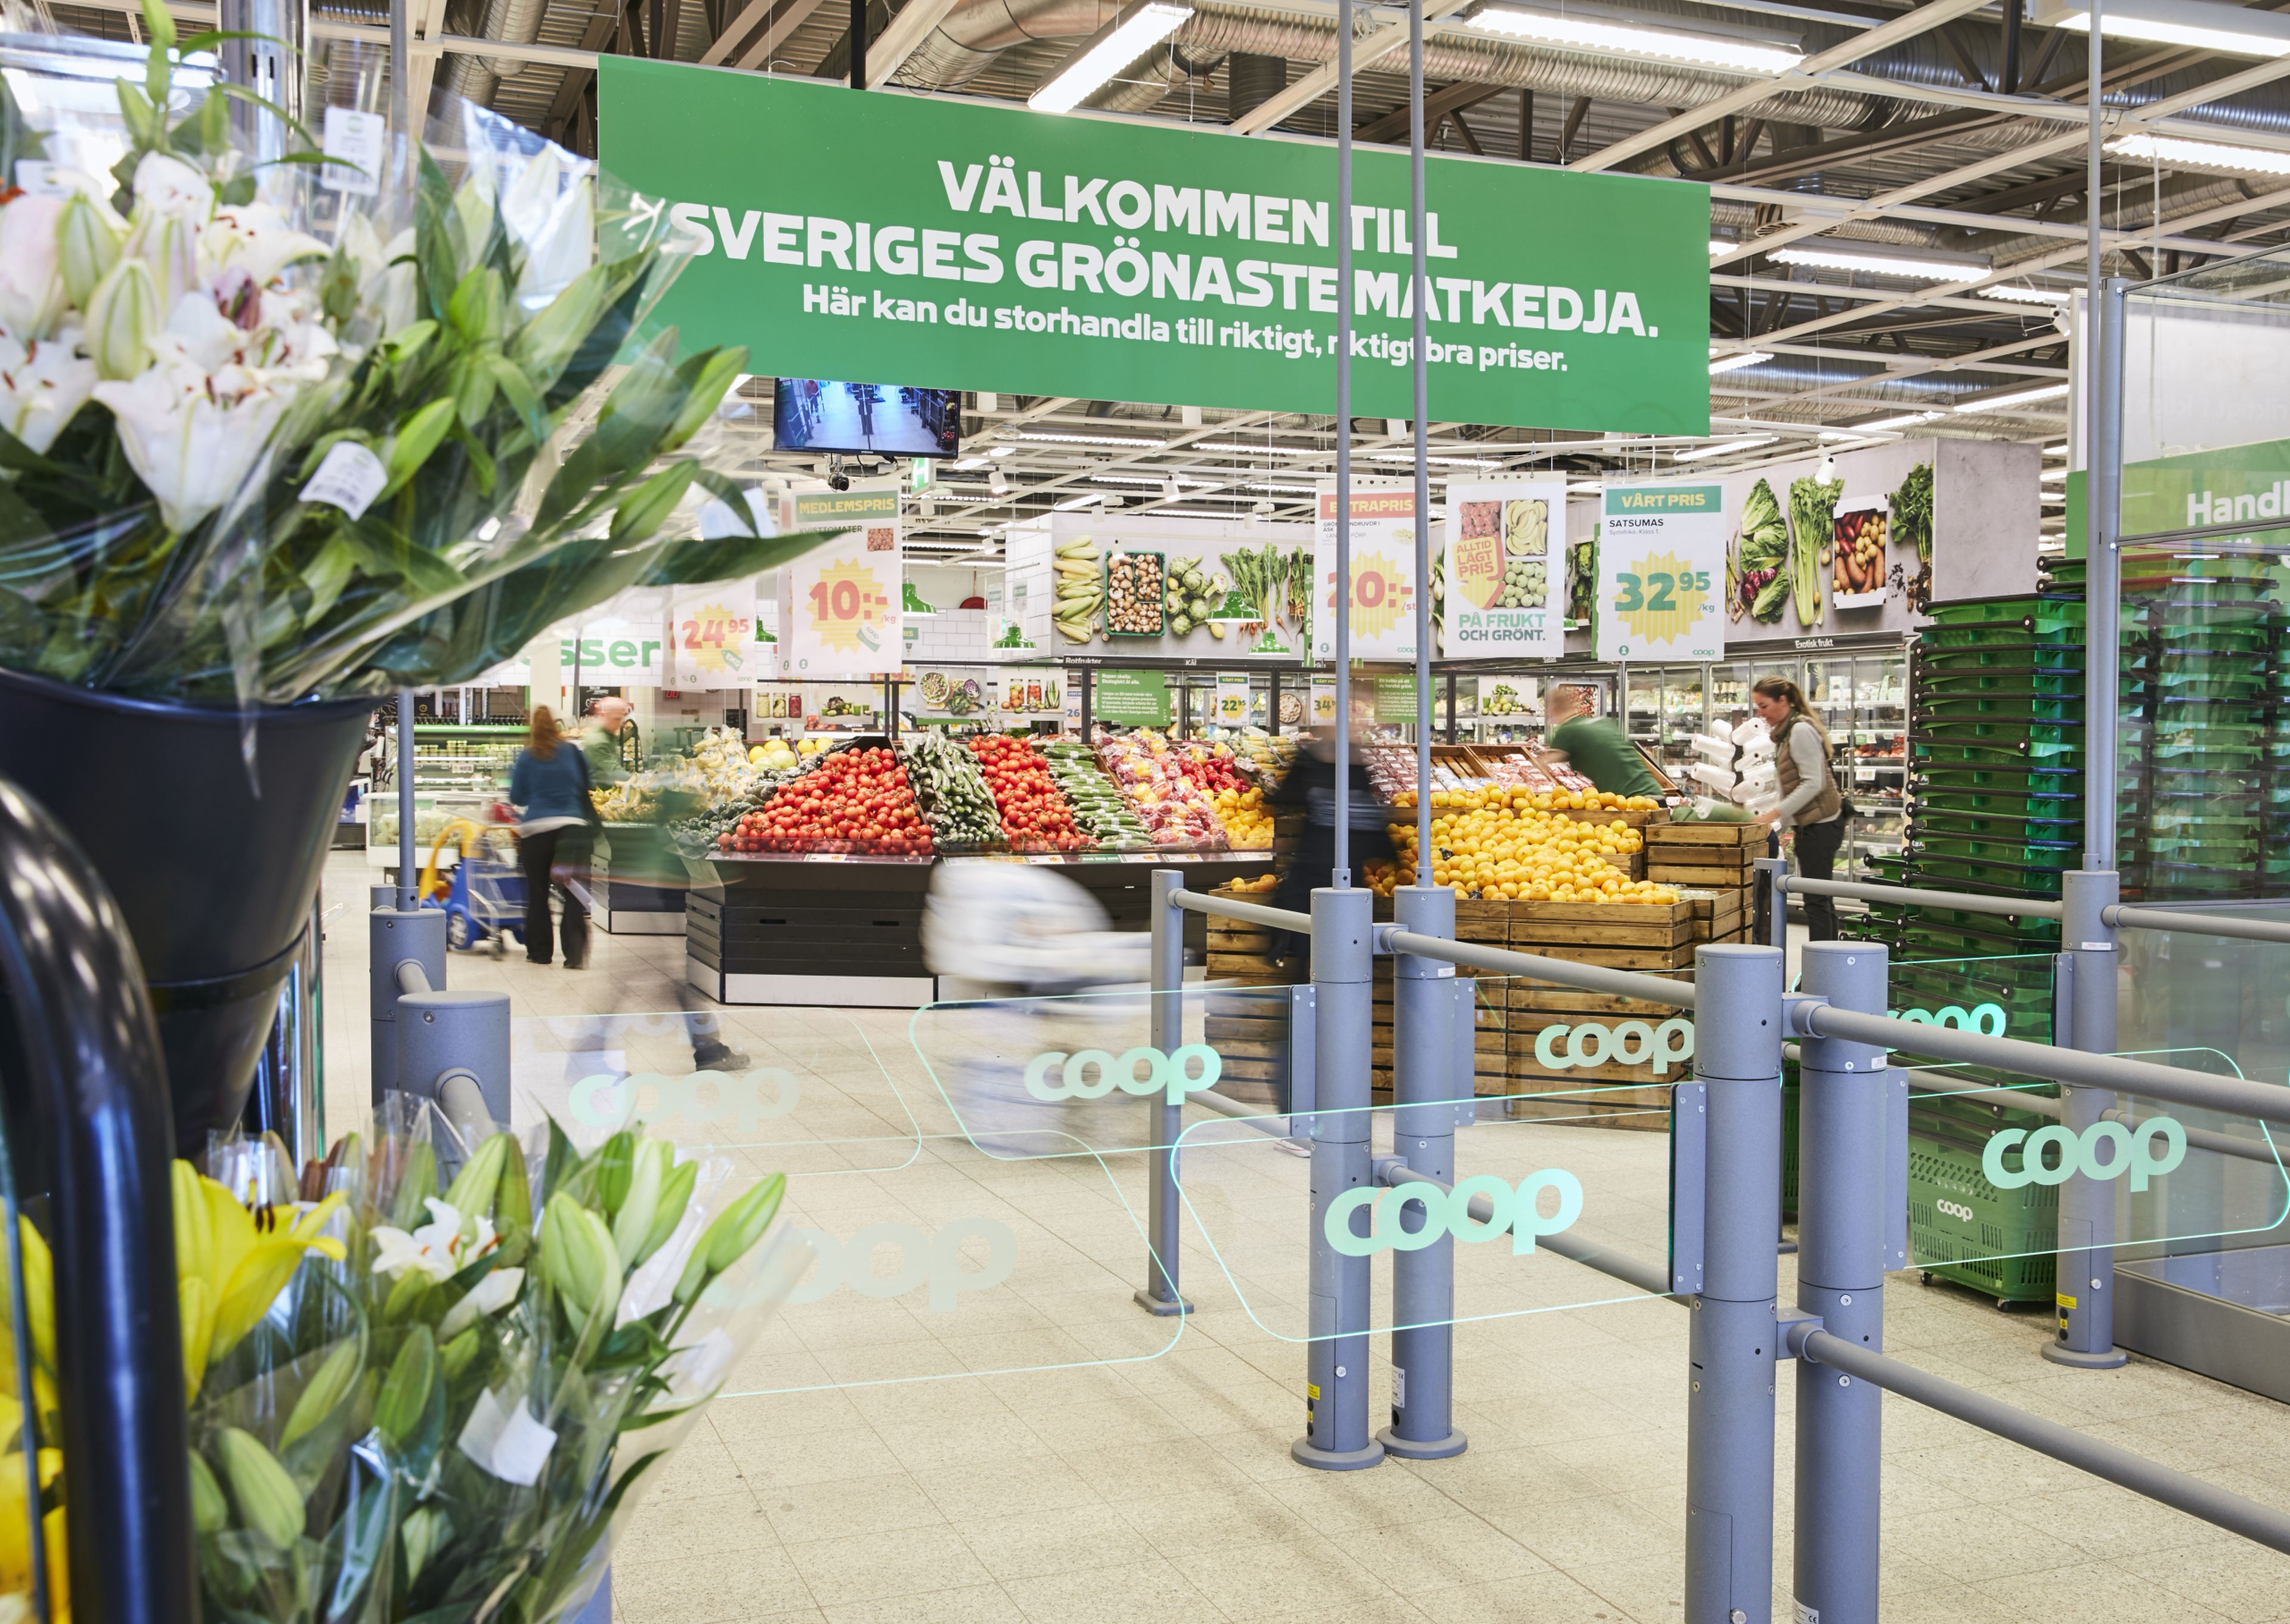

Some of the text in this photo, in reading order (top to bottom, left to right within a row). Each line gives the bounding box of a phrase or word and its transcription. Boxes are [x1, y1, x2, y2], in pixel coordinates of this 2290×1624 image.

[937, 154, 1457, 259] VÄLKOMMEN TILL
[670, 202, 1658, 337] SVERIGES GRÖNASTE MATKEDJA.
[803, 284, 1567, 371] Här kan du storhandla till riktigt, rktigt bra priser.
[799, 498, 895, 515] MEDLEMSPRIS
[1329, 500, 1413, 513] ETRAPRIS
[1621, 492, 1706, 507] VÅRT PRIS
[1609, 518, 1664, 527] SATSUMAS
[1456, 540, 1491, 553] ALLTID
[1457, 550, 1492, 565] LÅGT
[1459, 562, 1494, 577] PRIS
[809, 579, 888, 621] 10:-
[1698, 603, 1715, 613] /kg
[880, 614, 896, 624] /kg
[1459, 612, 1546, 628] PÅ FRUKT
[866, 627, 880, 639] coop
[1459, 628, 1546, 641] OCH GRÖNT.
[1794, 638, 1834, 649] Exotisk frukt
[1067, 708, 1081, 717] 26
[1534, 1018, 1695, 1075] coop
[1023, 1043, 1222, 1106] coop
[568, 1067, 801, 1134] coop
[1982, 1115, 2187, 1192] coop
[1324, 1167, 1584, 1256] coop
[1936, 1199, 1973, 1222] coop
